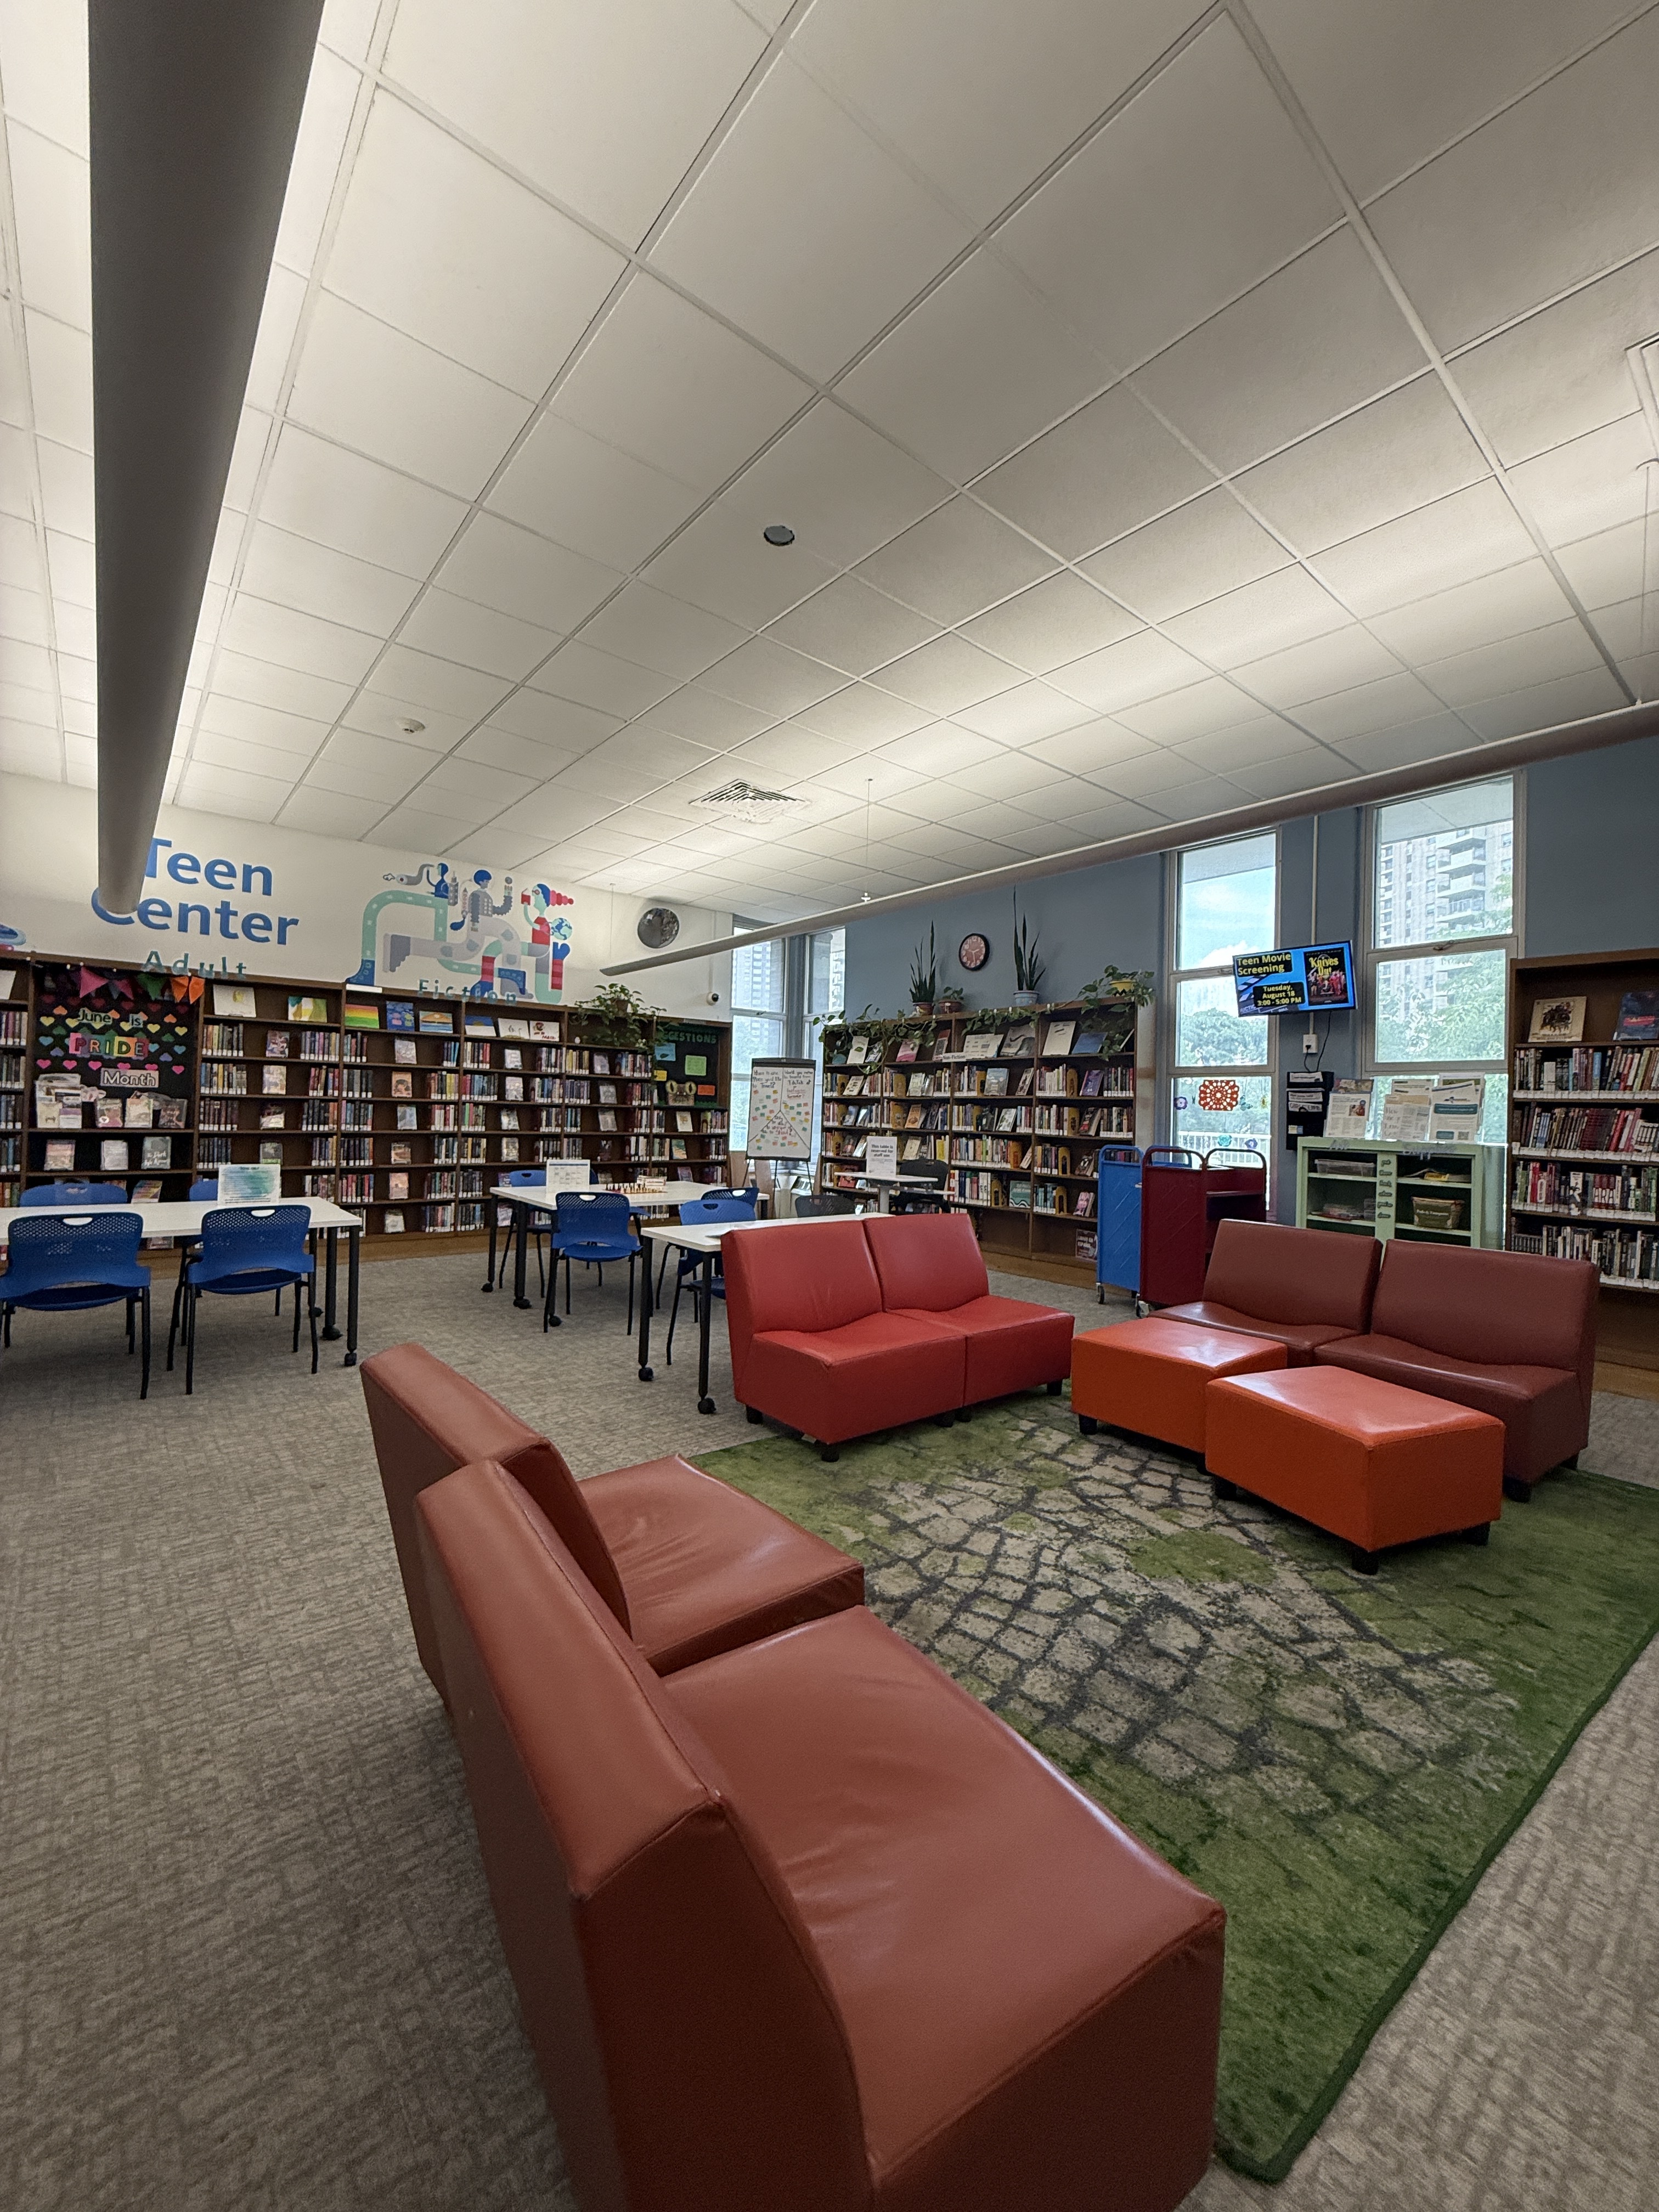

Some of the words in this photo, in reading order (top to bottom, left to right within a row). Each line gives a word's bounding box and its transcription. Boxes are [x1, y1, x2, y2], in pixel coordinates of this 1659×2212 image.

[145, 837, 273, 896] Teen
[91, 887, 300, 945] Center
[142, 951, 247, 980] Adult
[1237, 957, 1260, 966] Teen
[1262, 953, 1291, 963] Movie
[1309, 956, 1339, 968] Knives
[1238, 963, 1285, 976] Screening
[417, 979, 517, 1006] Fiction
[1257, 998, 1272, 1007] 3:00
[78, 1009, 111, 1023] June
[75, 1037, 145, 1057] PRIDE
[103, 1070, 156, 1086] Month
